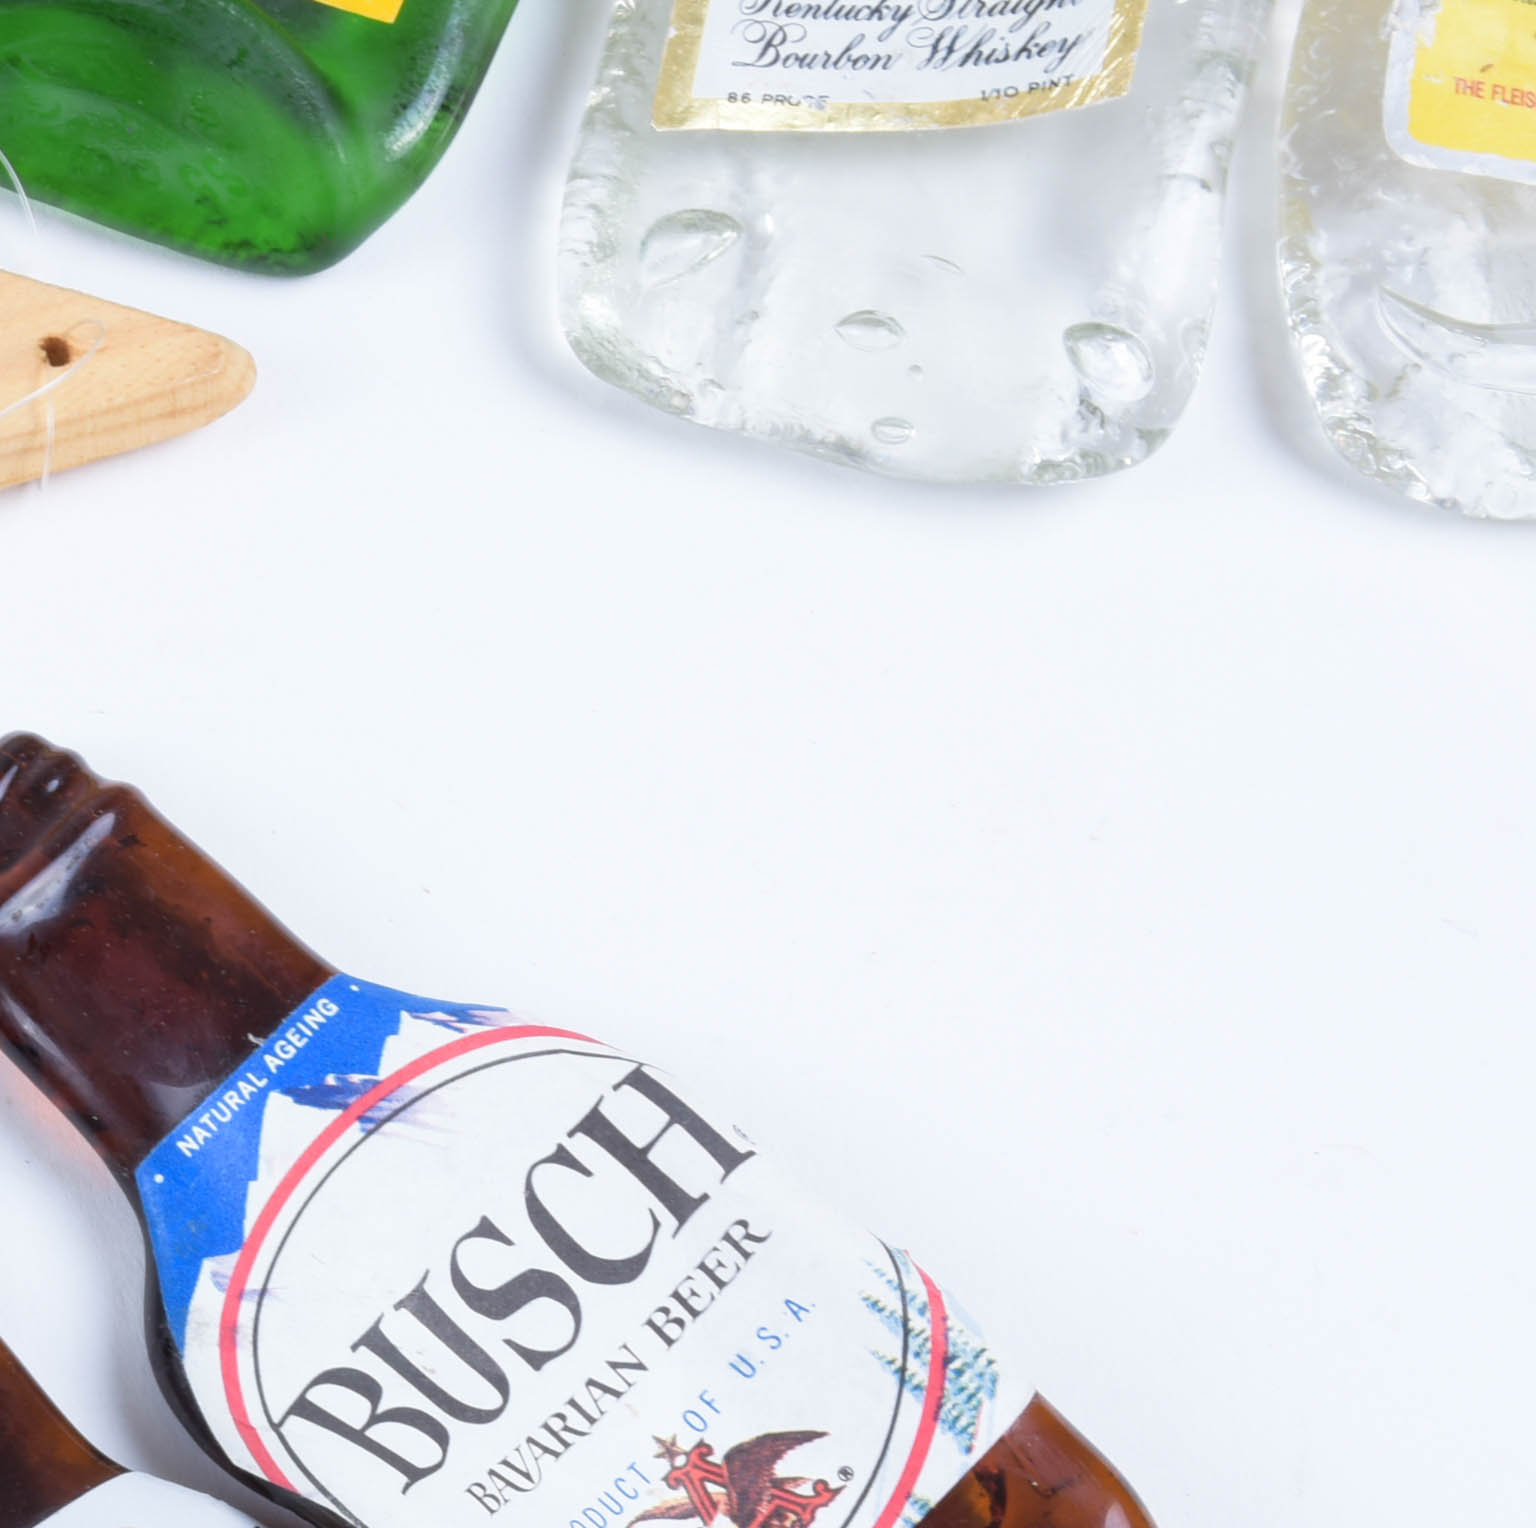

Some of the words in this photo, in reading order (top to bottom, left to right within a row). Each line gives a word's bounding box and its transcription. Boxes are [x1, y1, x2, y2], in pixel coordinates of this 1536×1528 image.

[731, 19, 898, 70] Bourbon
[906, 21, 1085, 74] Whiskey
[727, 92, 752, 104] 86
[1027, 73, 1074, 93] PINT
[1454, 76, 1485, 99] THE
[1492, 83, 1536, 108] FLEIS
[176, 1072, 268, 1157] NATURAL
[263, 998, 340, 1074] AGEING
[273, 1063, 757, 1495] BUSCH
[465, 1343, 649, 1514] BAVARIAN
[642, 1218, 772, 1350] BEER
[682, 1389, 721, 1433] OF
